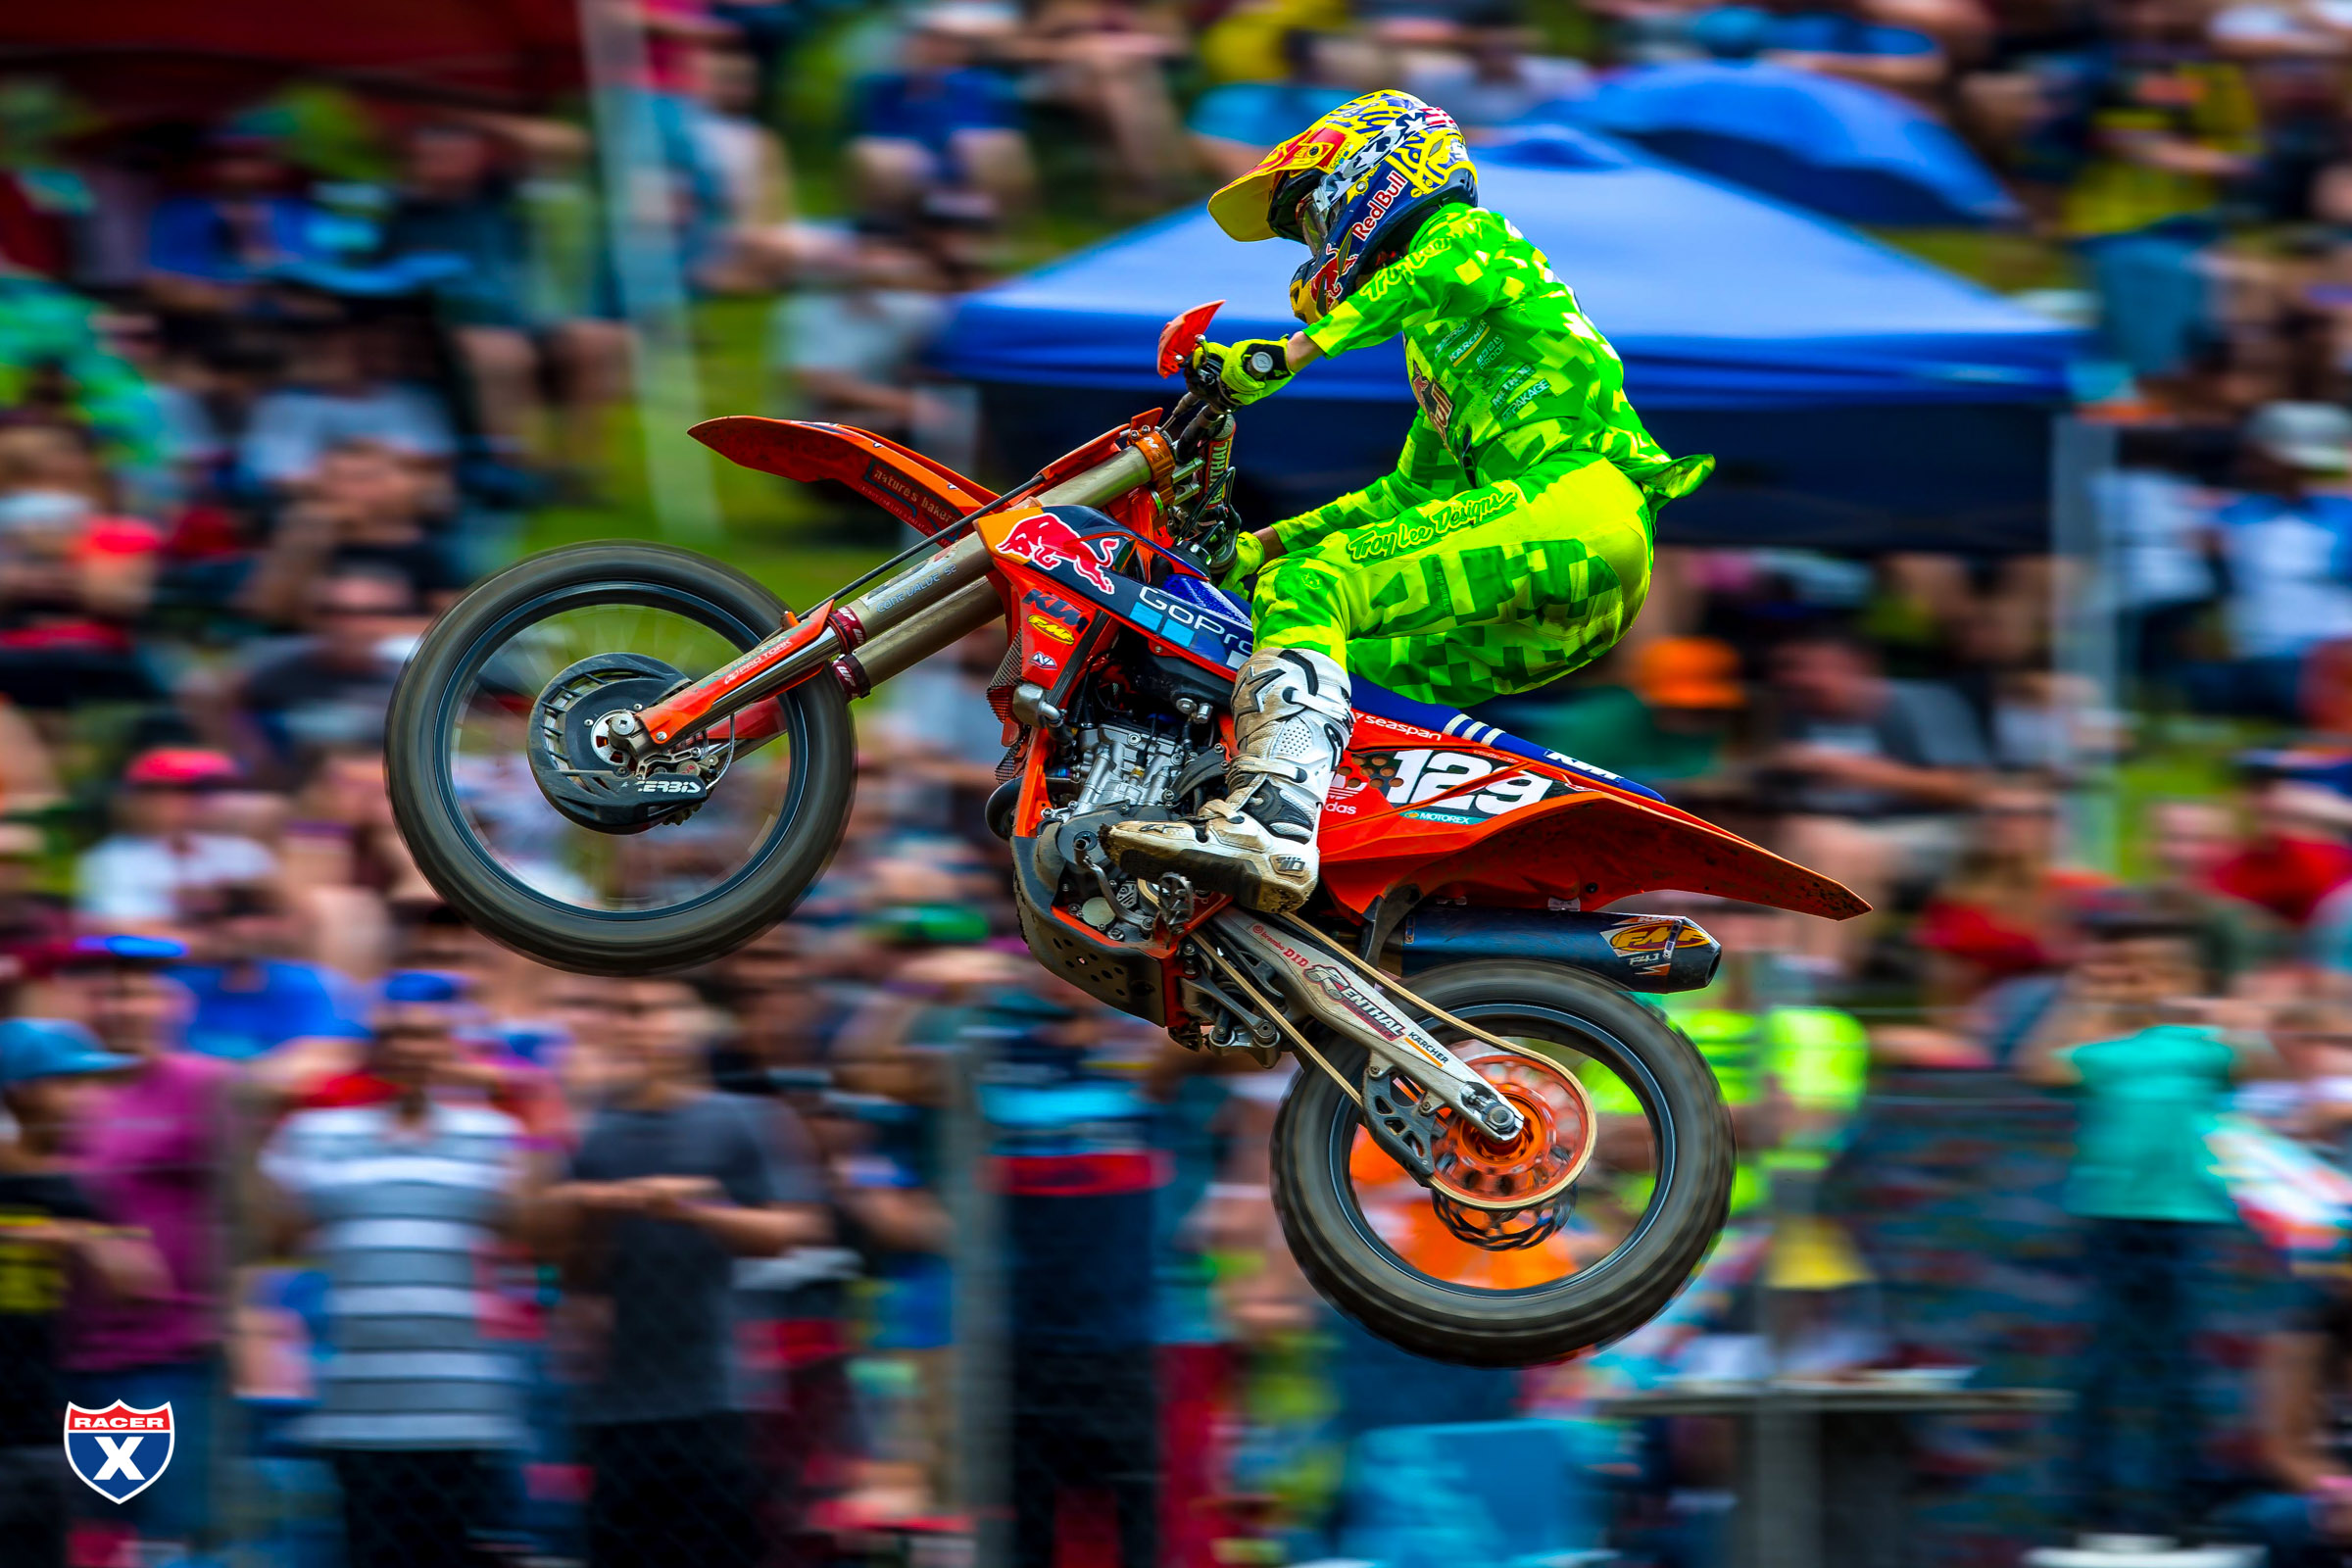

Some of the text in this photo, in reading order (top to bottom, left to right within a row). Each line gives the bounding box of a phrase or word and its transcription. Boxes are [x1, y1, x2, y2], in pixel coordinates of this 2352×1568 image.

[1348, 492, 1518, 561] Troy Lee Designs
[1021, 588, 1090, 634] KTM
[1028, 616, 1075, 645] FMF
[1364, 715, 1443, 742] seaspan
[1385, 749, 1554, 815] 129
[1420, 812, 1471, 825] MOTOREX
[1260, 931, 1286, 951] brembo
[1303, 964, 1406, 1036] RENTHAL
